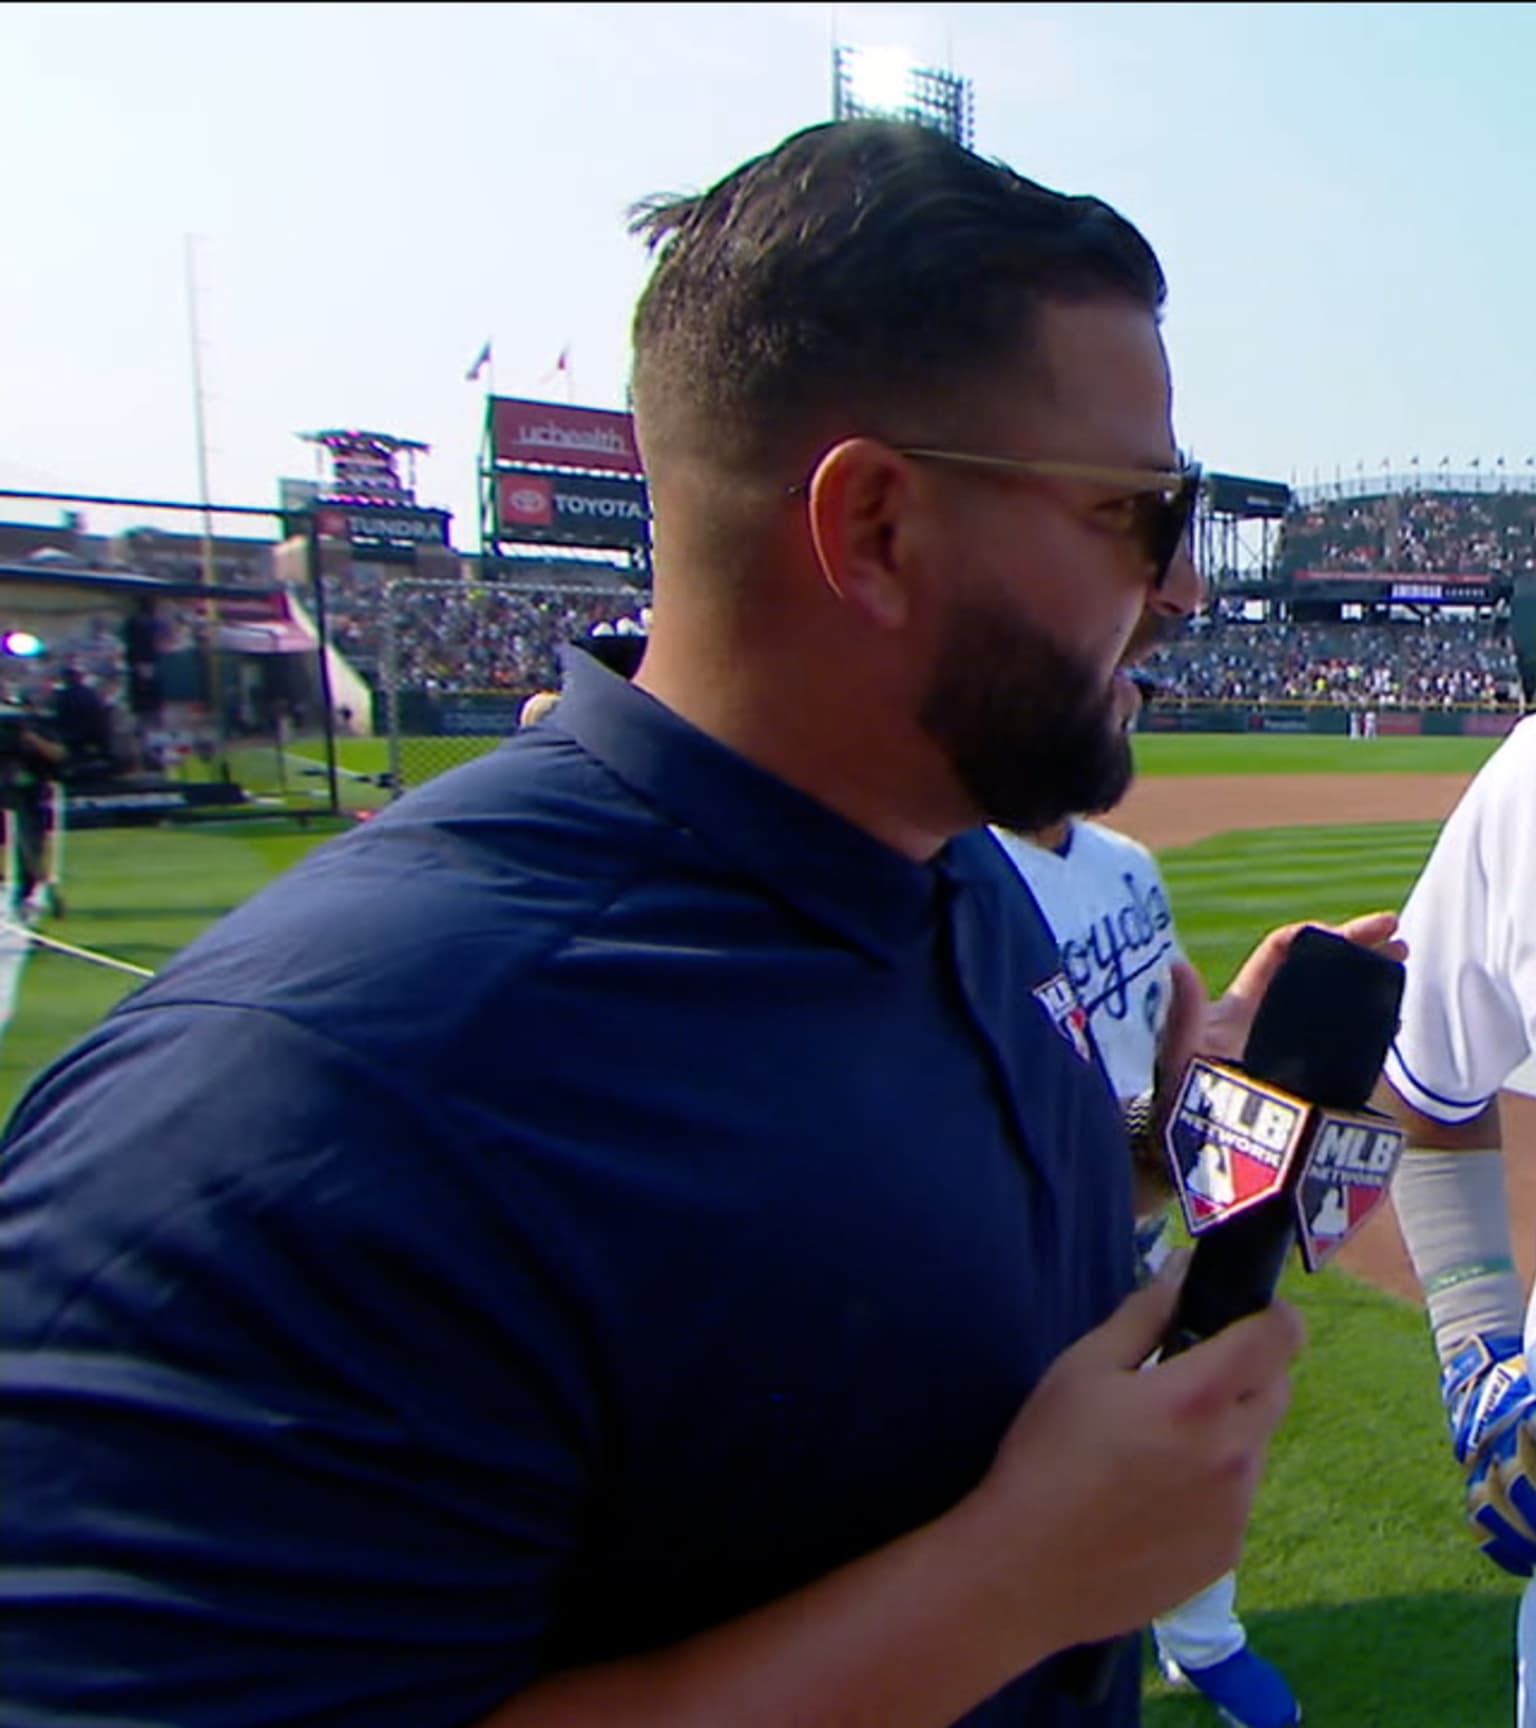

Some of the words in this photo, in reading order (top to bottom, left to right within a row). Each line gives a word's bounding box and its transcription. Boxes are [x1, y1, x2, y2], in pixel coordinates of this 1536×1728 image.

[516, 422, 630, 454] uchealth
[554, 494, 645, 518] TOYOTA
[349, 516, 442, 540] TUNDRA
[1061, 872, 1171, 1020] oyals
[1193, 1068, 1296, 1150] MLB
[1179, 1110, 1284, 1168] NETWORK
[1315, 1122, 1398, 1173] MLB
[1304, 1163, 1386, 1186] NETWORK
